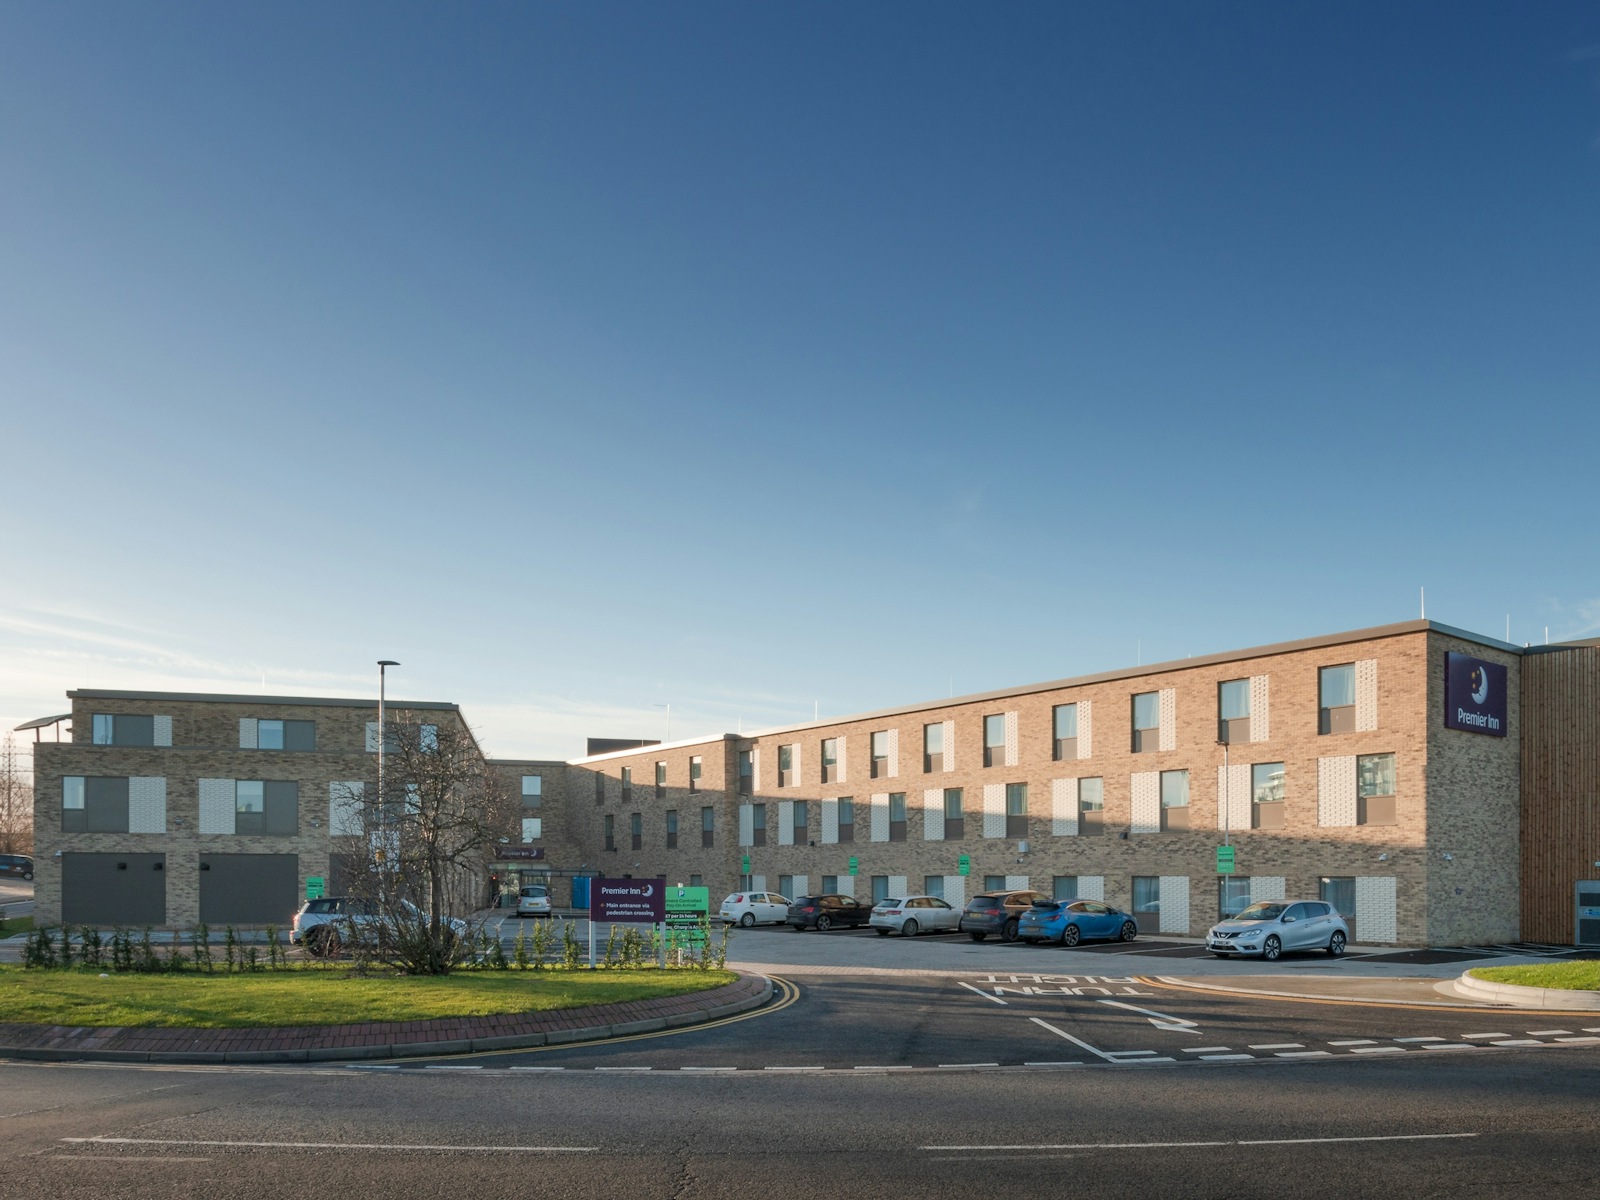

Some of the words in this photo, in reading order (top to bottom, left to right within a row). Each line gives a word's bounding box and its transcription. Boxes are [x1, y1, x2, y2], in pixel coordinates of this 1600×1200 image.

[1458, 708, 1487, 726] Premier
[1488, 714, 1499, 730] Inn
[601, 887, 629, 895] Premier
[629, 887, 641, 895] Inn
[976, 975, 1140, 984] RIGHT
[993, 986, 1154, 996] TURN
